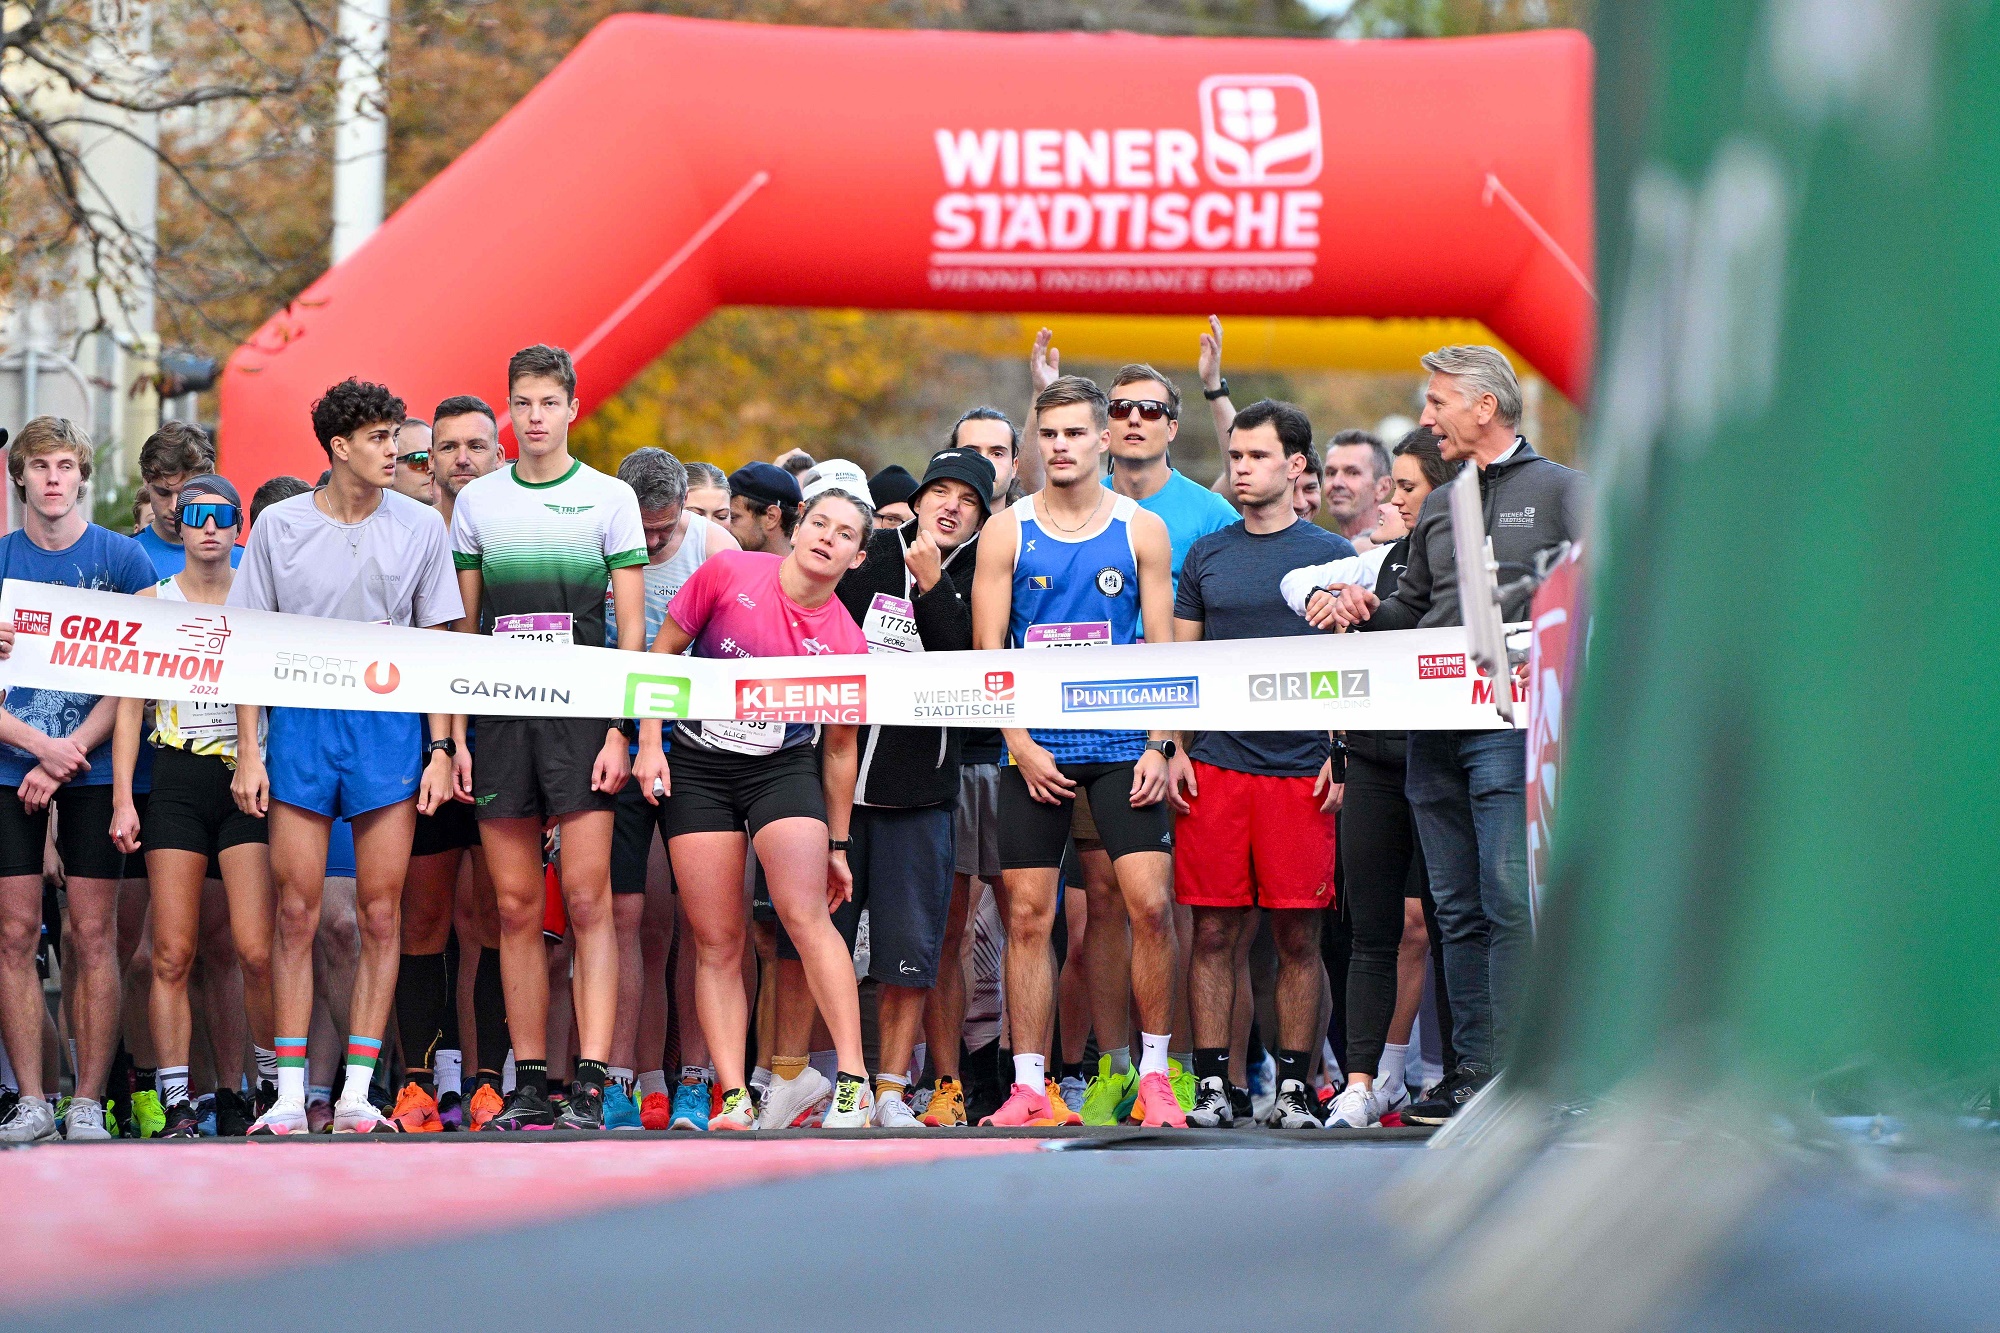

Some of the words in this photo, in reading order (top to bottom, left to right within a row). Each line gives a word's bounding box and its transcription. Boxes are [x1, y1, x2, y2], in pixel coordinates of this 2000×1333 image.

[934, 129, 1200, 187] WIENER
[931, 190, 1323, 250] STÄDTISCHE
[927, 269, 1037, 293] VIENNA
[1041, 269, 1207, 294] INSURANCE
[1210, 269, 1314, 293] GROUP
[13, 621, 48, 633] EITUNG
[14, 610, 50, 623] LEINE
[880, 614, 919, 636] 17759
[60, 614, 142, 646] GRAZ
[49, 640, 224, 683] MARATHON
[275, 651, 358, 673] SPORT
[1420, 656, 1464, 667] KLEINE
[1420, 666, 1465, 677] ZEITUNG
[189, 684, 219, 695] 2024
[450, 678, 571, 705] GARMIN
[742, 683, 860, 709] KLEINE
[914, 689, 982, 704] WIENER
[1072, 685, 1189, 707] PUNTIGAMER
[1251, 673, 1366, 700] GRAZ
[914, 703, 1016, 717] STÄDTISCHE
[1323, 699, 1371, 709] HOLDING
[722, 729, 747, 740] ALICE
